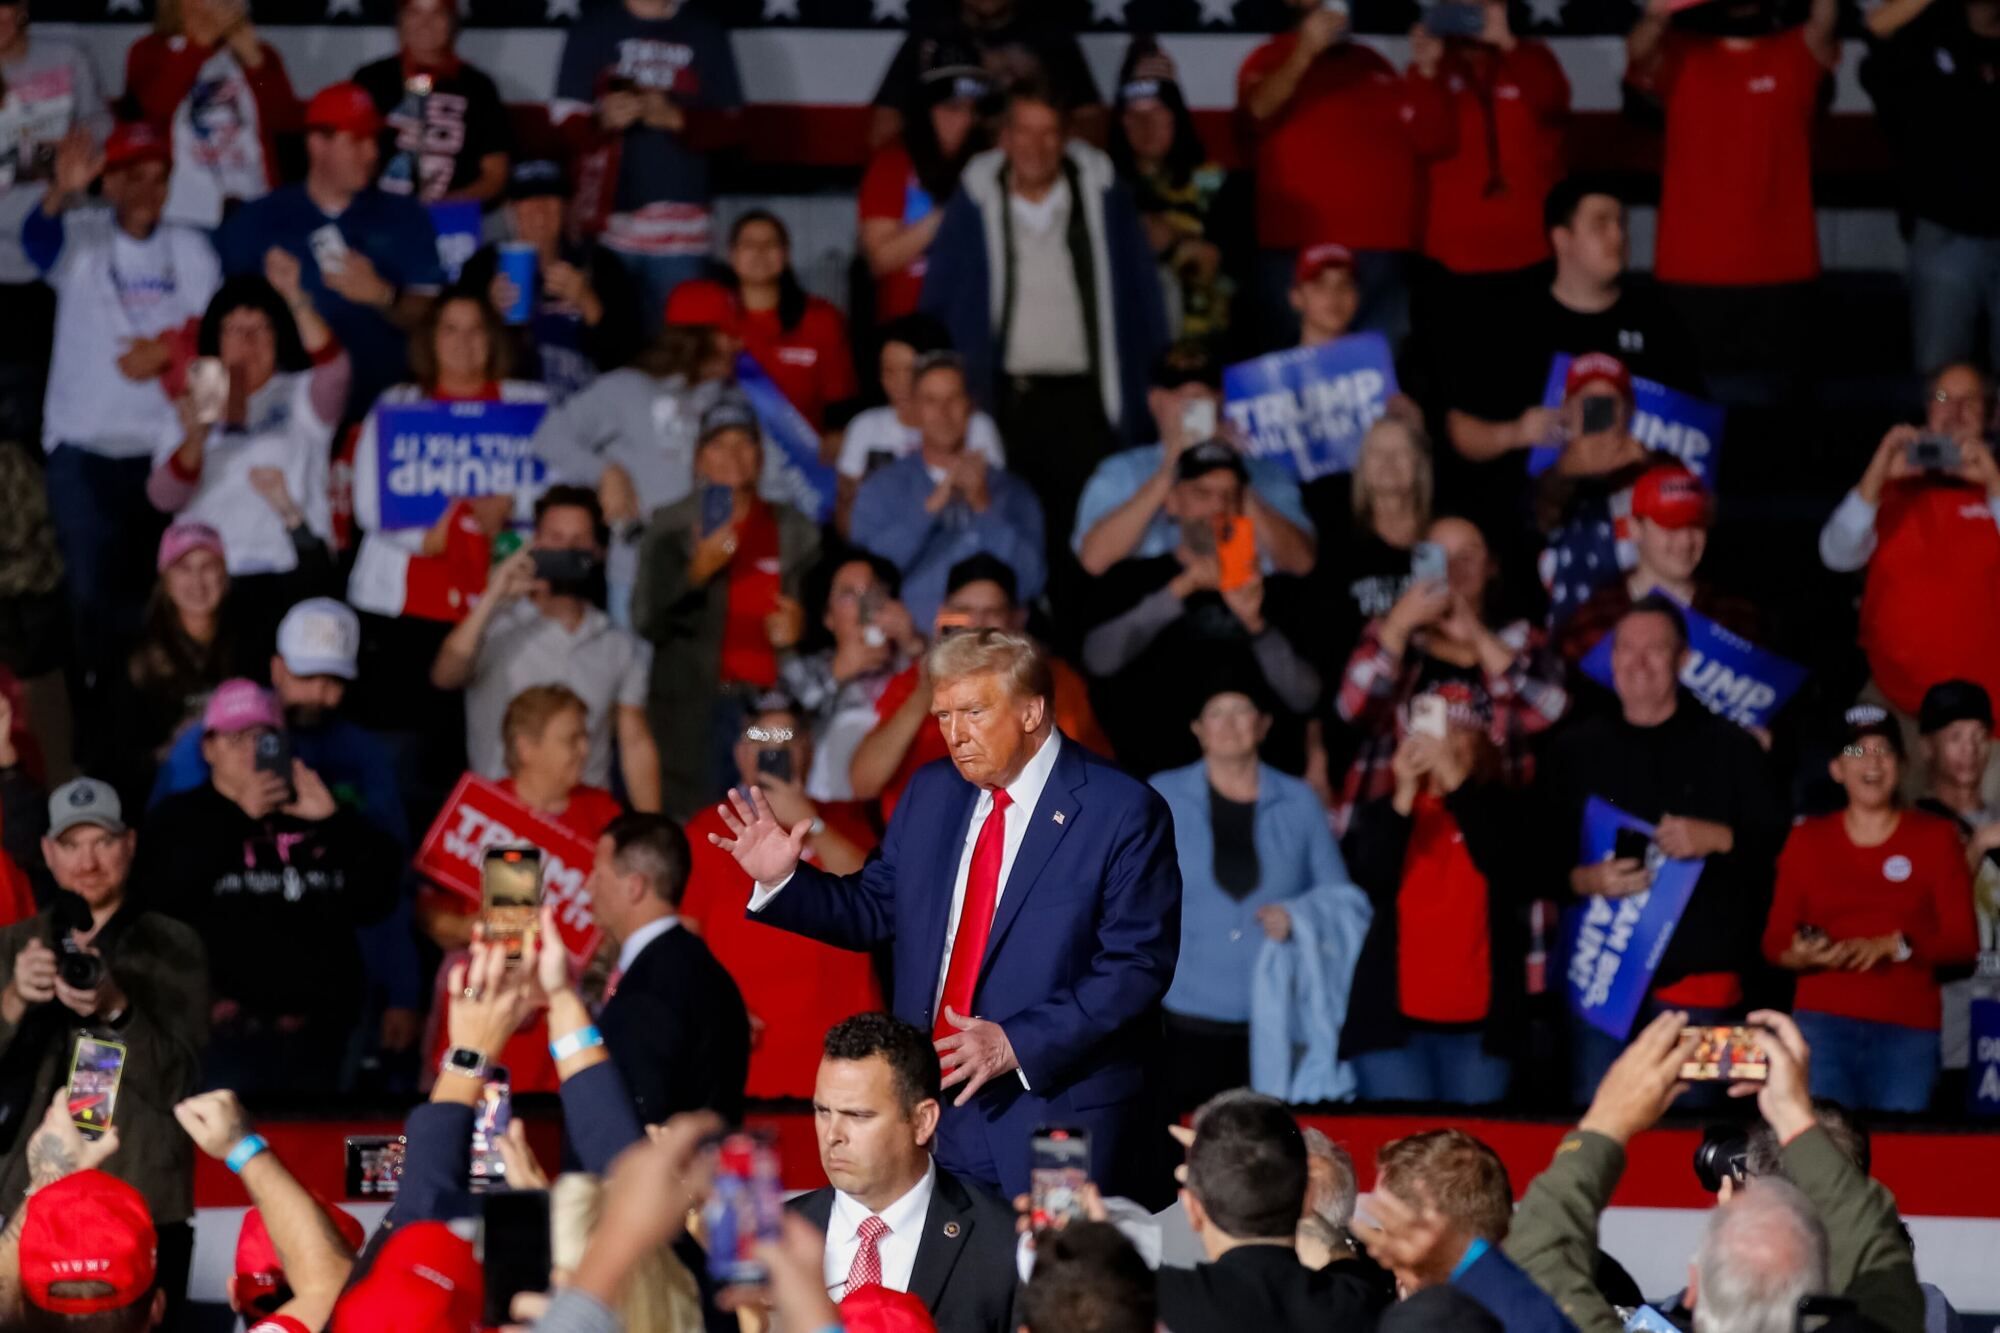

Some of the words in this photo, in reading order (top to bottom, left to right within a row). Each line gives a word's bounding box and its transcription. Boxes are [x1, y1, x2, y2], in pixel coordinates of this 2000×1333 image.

[1229, 368, 1384, 438] TRUMP
[387, 457, 547, 498] TRUMP
[1679, 650, 1776, 709] UMP
